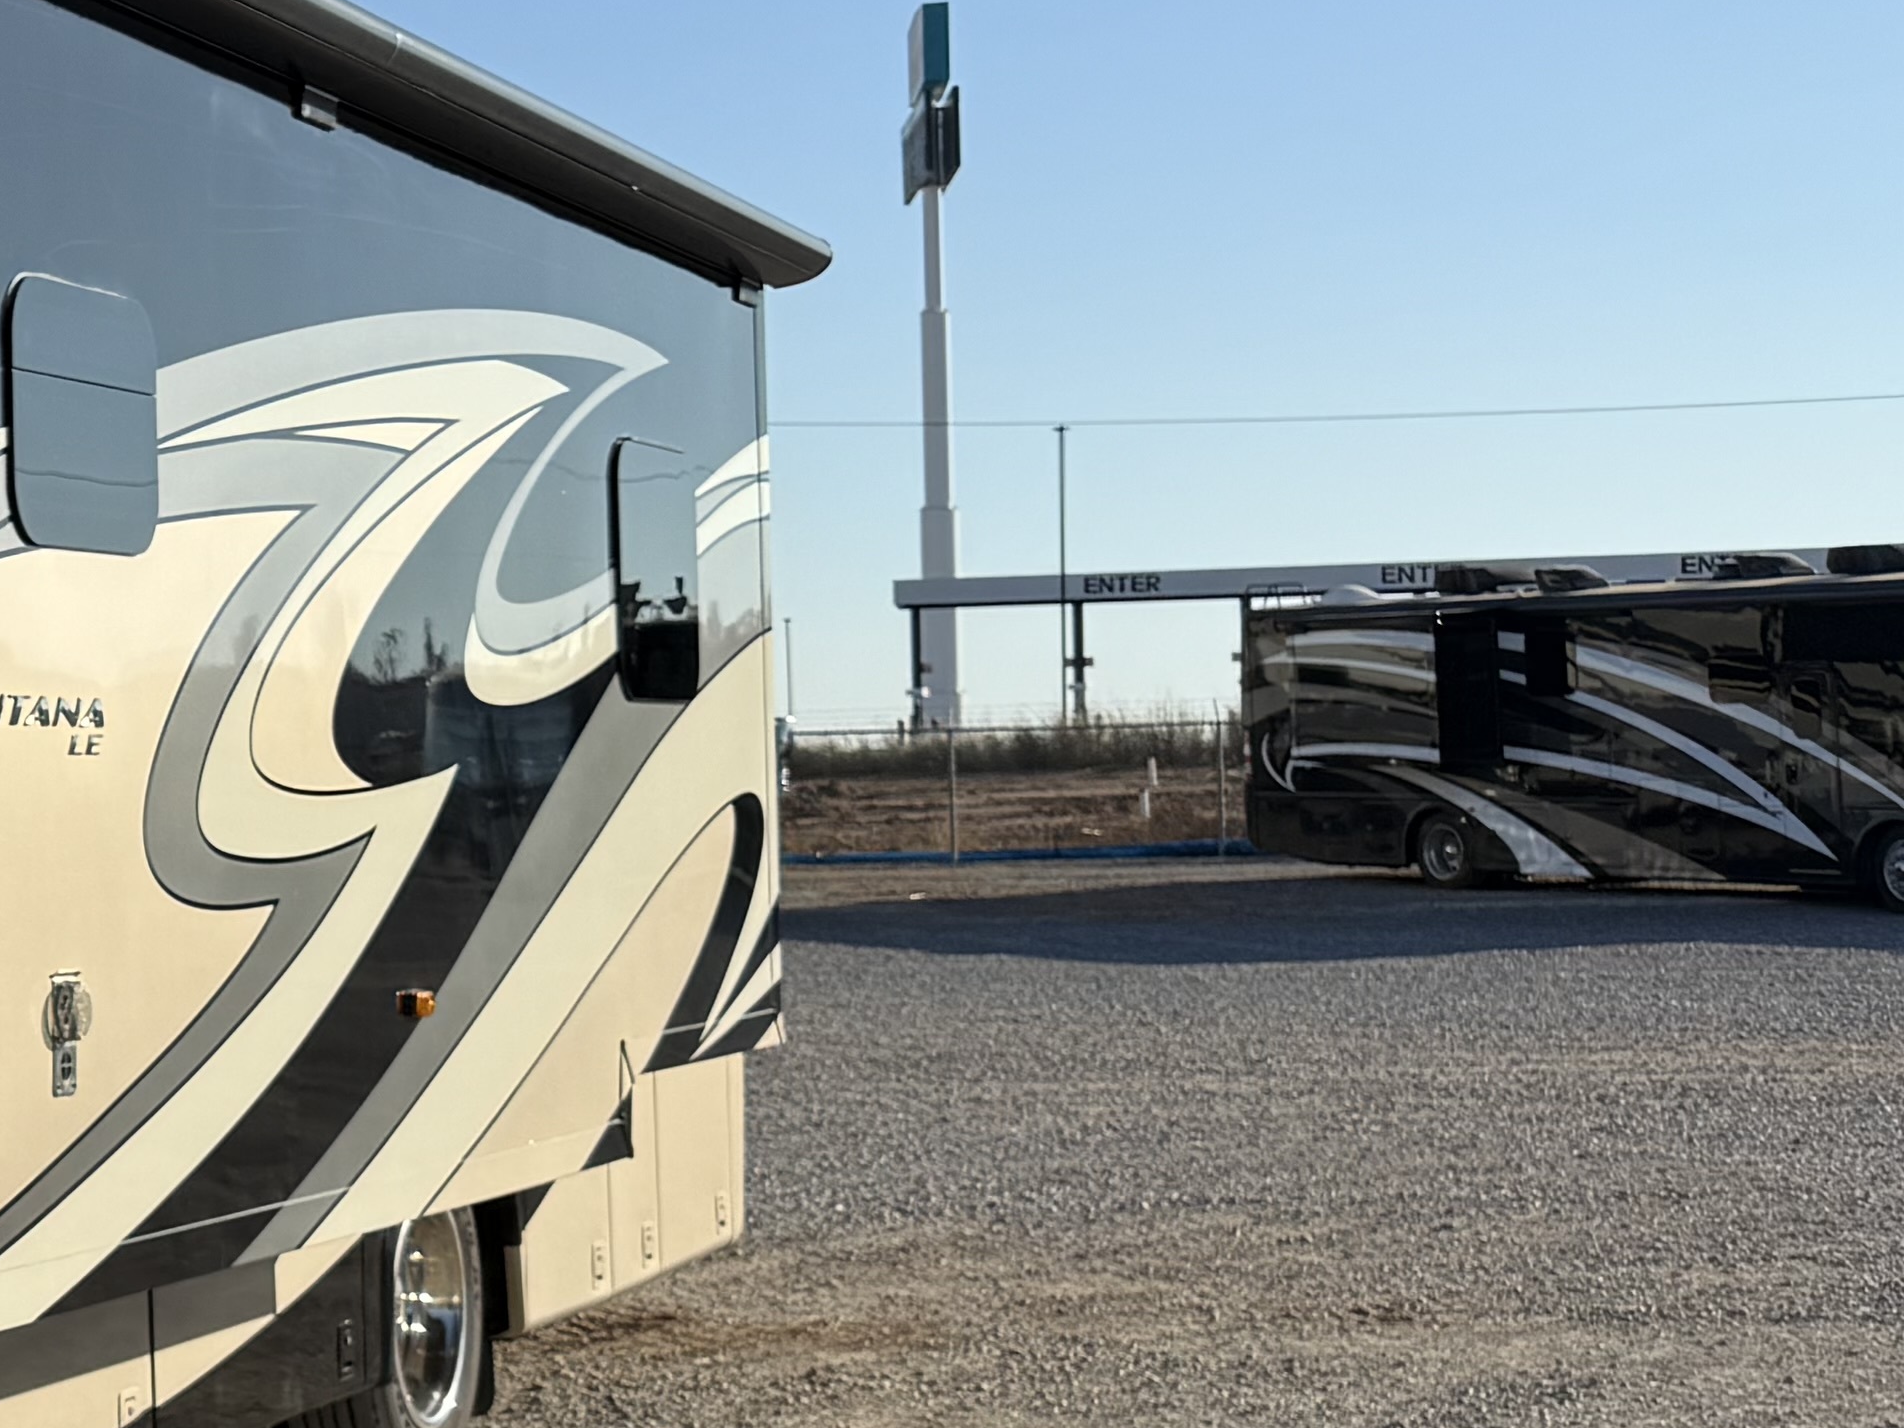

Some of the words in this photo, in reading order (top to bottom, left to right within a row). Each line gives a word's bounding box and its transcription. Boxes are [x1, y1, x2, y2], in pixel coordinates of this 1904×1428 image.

[1083, 574, 1162, 595] ENTER
[1380, 563, 1465, 585] ENT
[67, 733, 104, 755] LE
